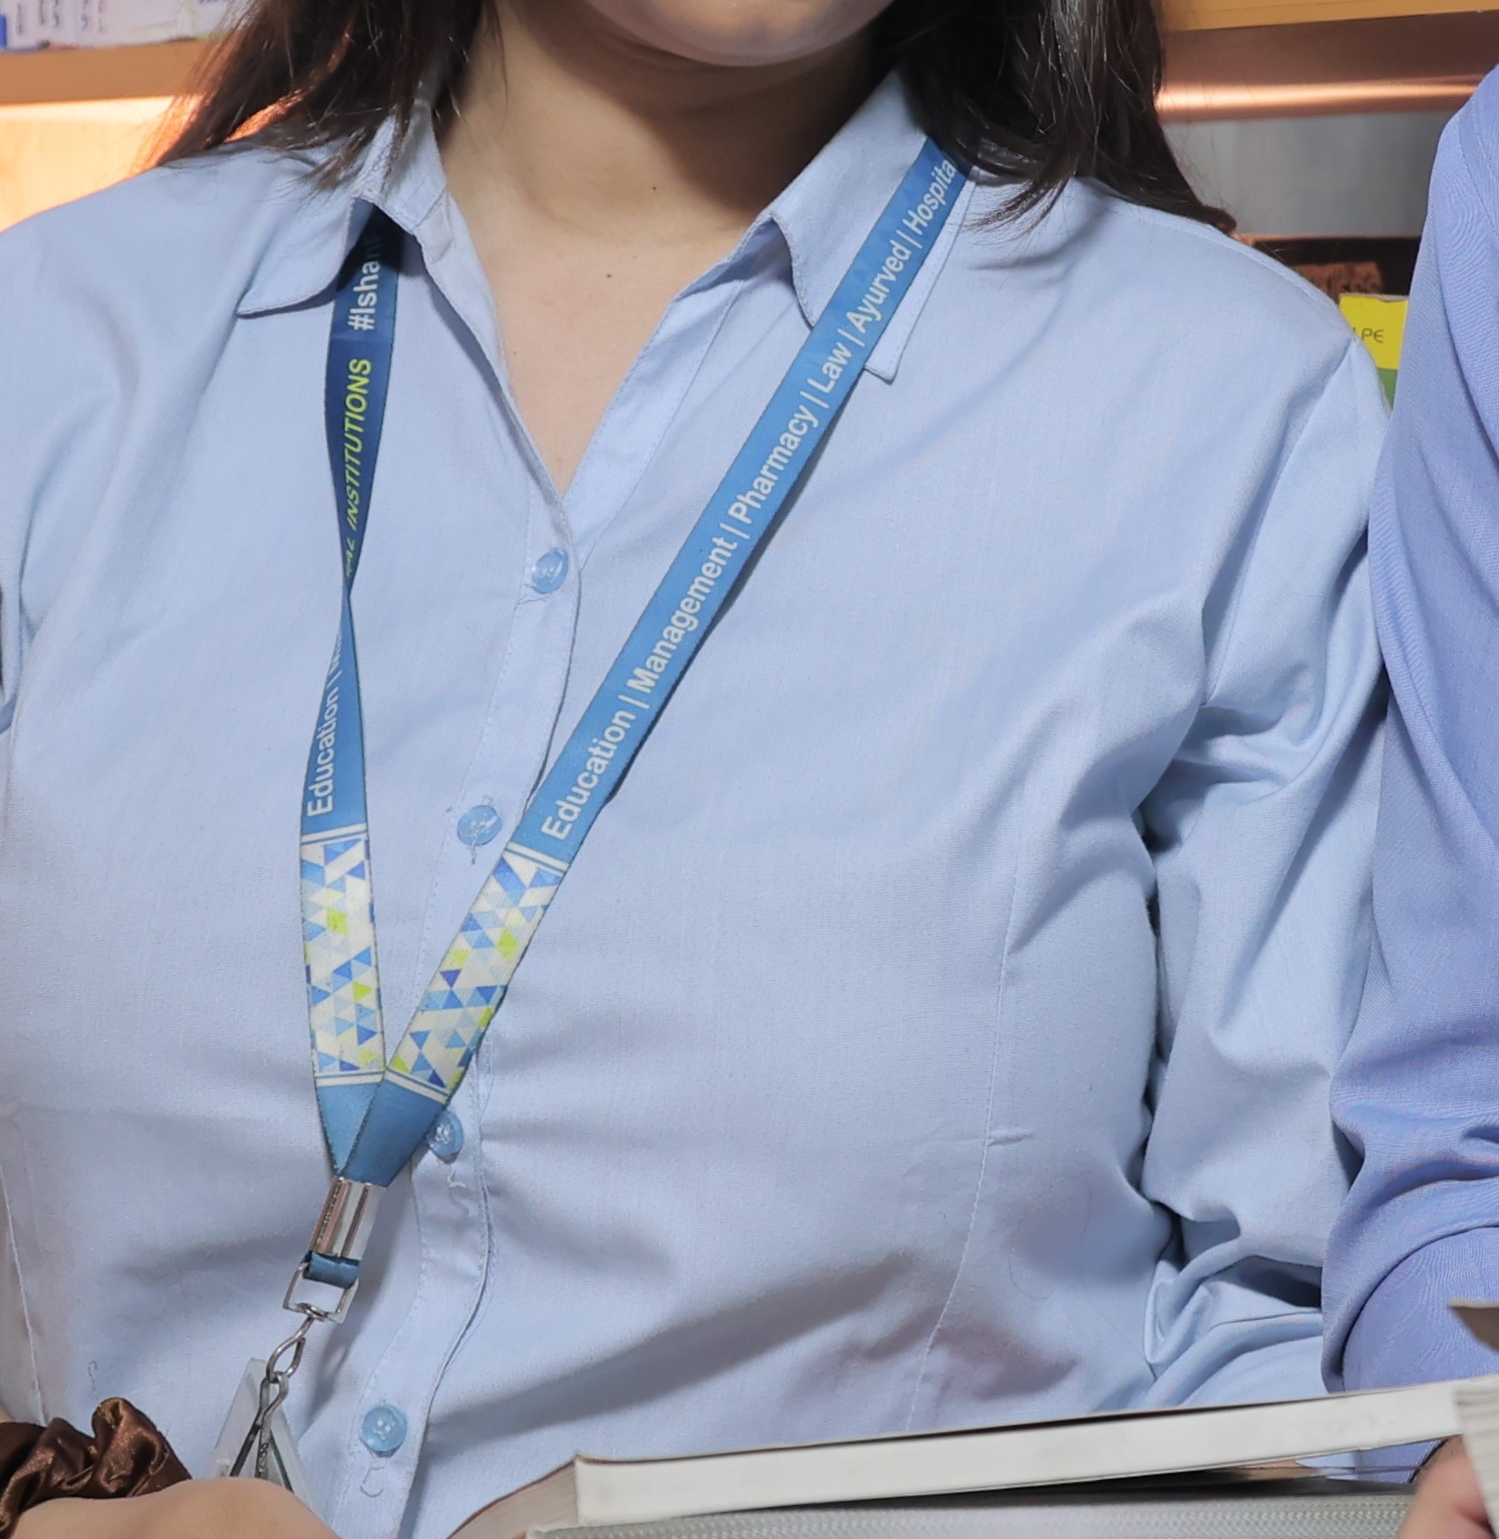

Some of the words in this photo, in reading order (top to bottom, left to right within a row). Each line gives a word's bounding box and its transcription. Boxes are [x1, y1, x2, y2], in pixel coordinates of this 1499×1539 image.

[345, 356, 372, 531] INSTITUTIONS
[540, 710, 631, 841] Education
[628, 535, 739, 691] Management
[730, 403, 823, 526] Pharmacy
[811, 340, 852, 395] Law
[845, 237, 913, 335] Ayurved
[903, 157, 955, 238] Hospita
[307, 685, 341, 817] Education
